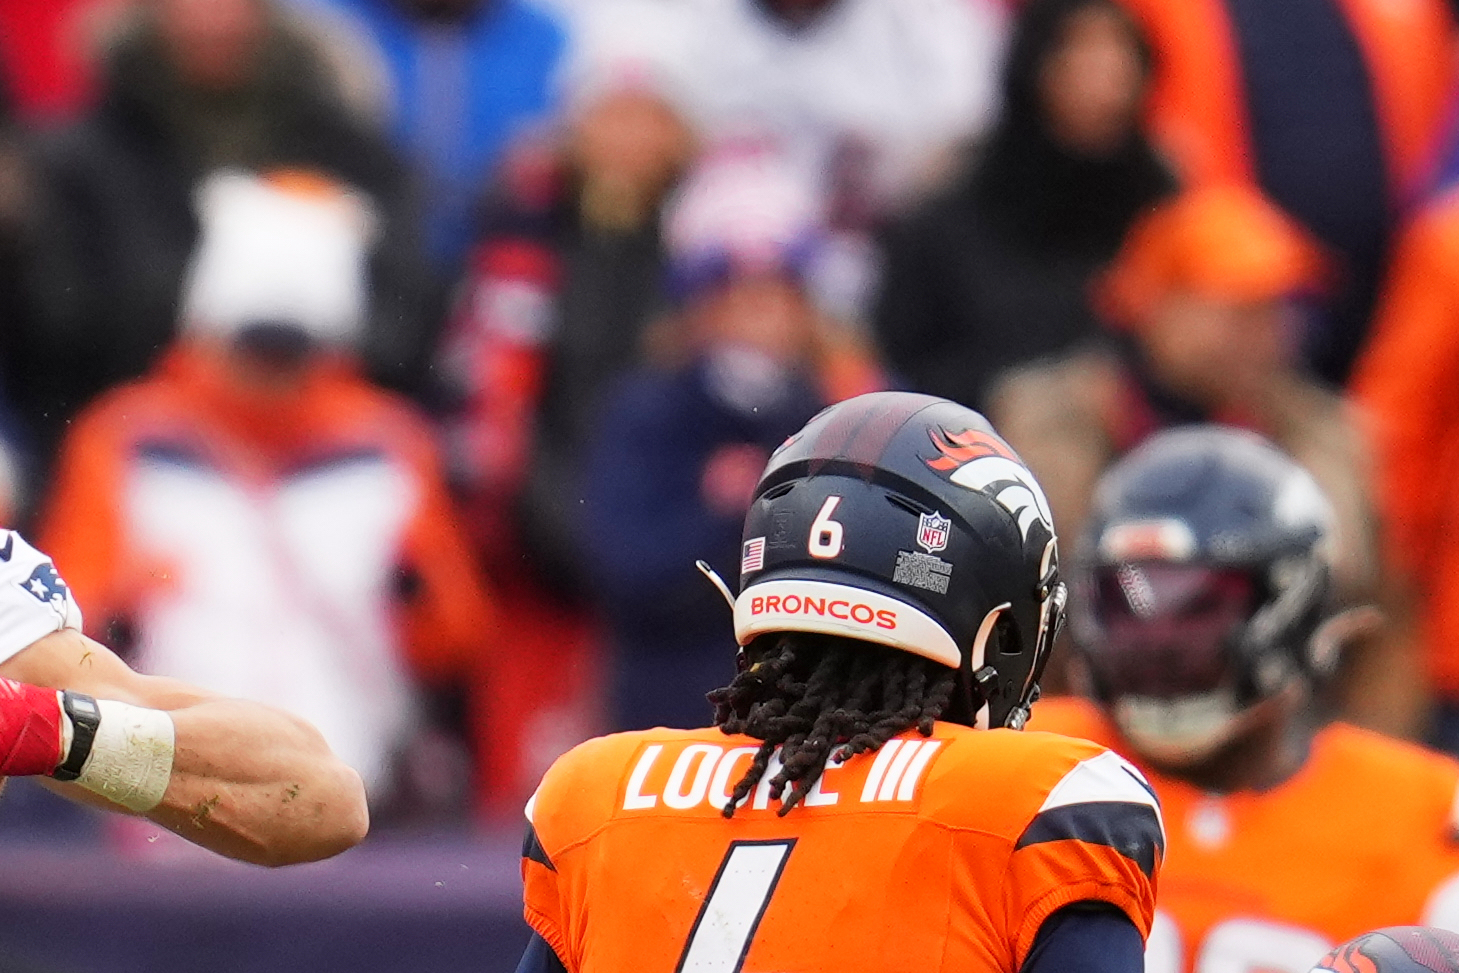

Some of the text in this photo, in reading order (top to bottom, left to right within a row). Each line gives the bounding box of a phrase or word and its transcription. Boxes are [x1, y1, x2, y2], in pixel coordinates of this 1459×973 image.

[808, 495, 844, 559] 6
[922, 527, 945, 547] NFL
[751, 594, 897, 630] BRONCOS
